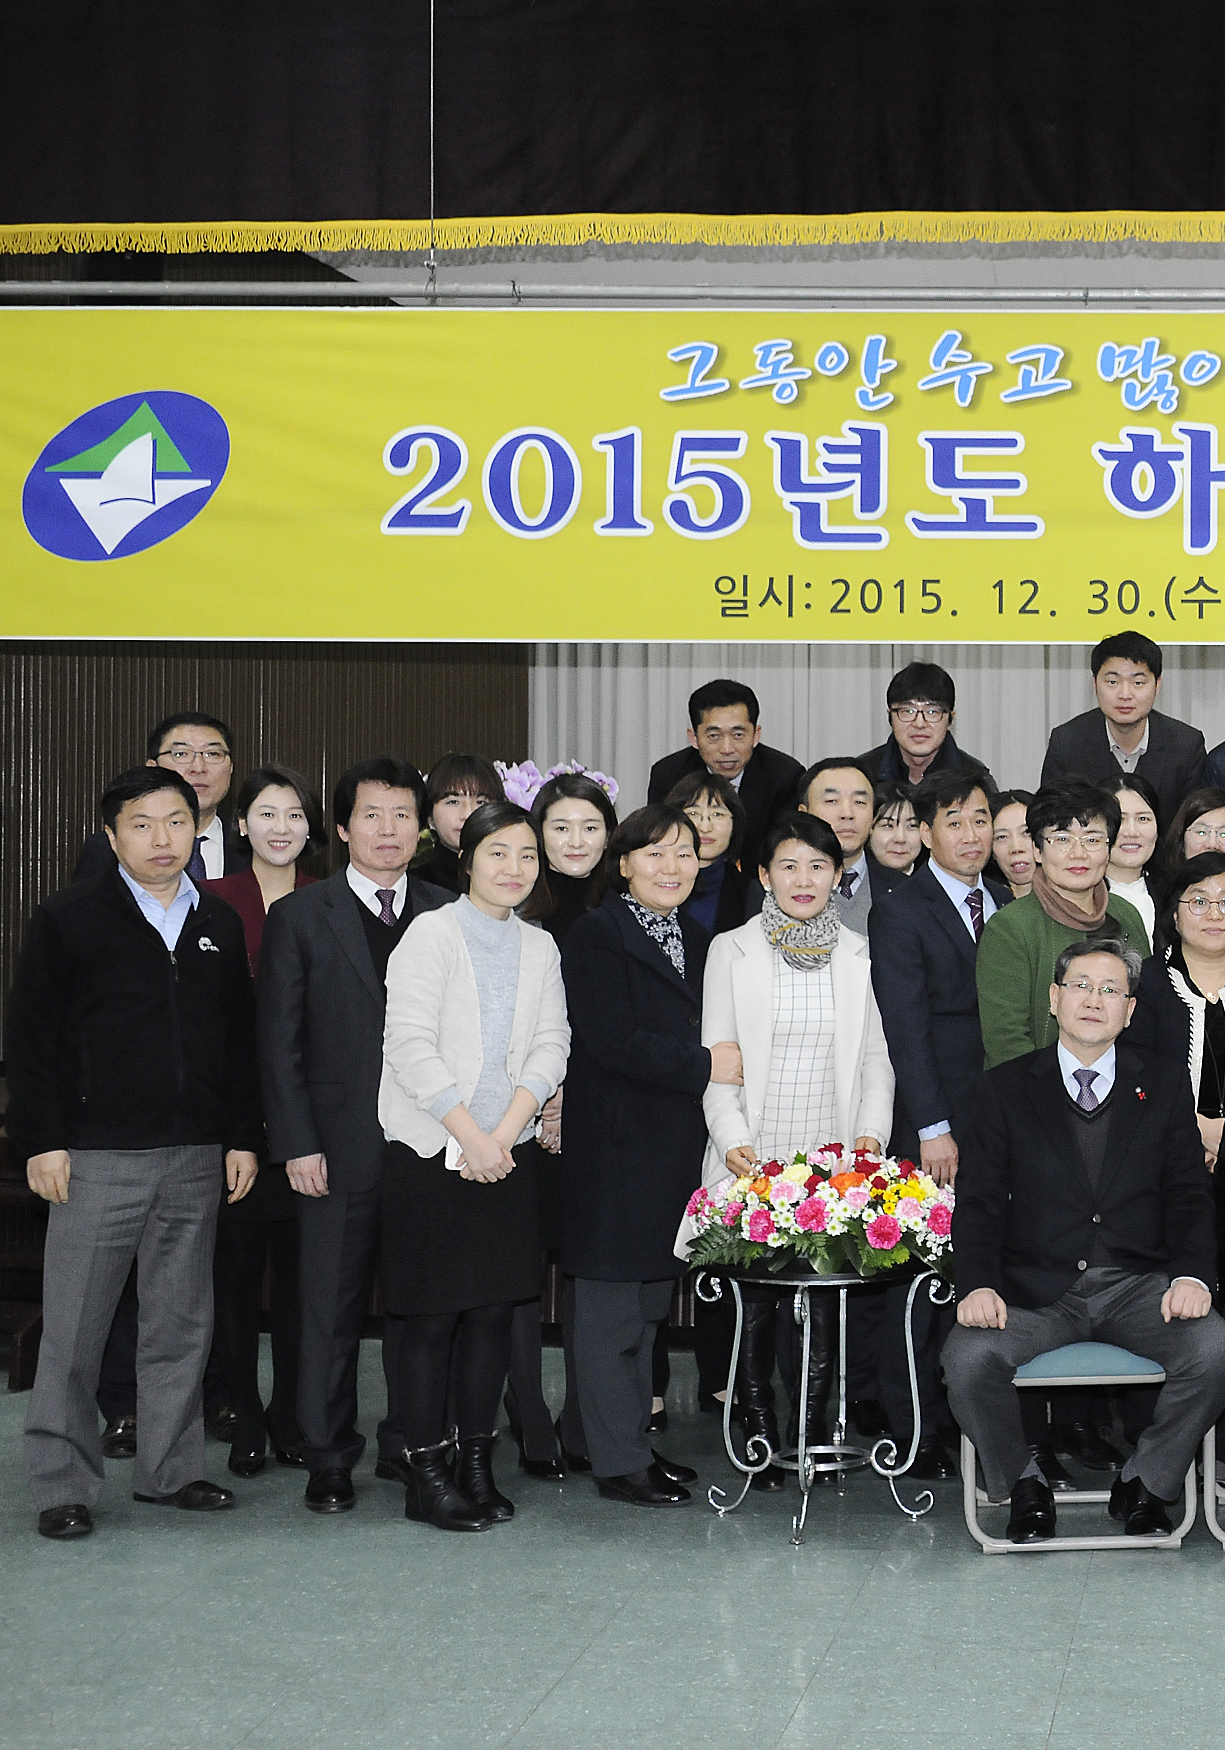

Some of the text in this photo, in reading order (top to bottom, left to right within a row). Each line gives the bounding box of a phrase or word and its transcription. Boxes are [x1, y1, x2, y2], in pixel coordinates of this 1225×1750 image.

[659, 334, 897, 411] 그동안
[917, 330, 1072, 407] 수고
[380, 419, 1045, 550] 2015년도
[714, 574, 812, 618] 일시:
[830, 578, 958, 617] 2015.
[992, 579, 1057, 617] 12.
